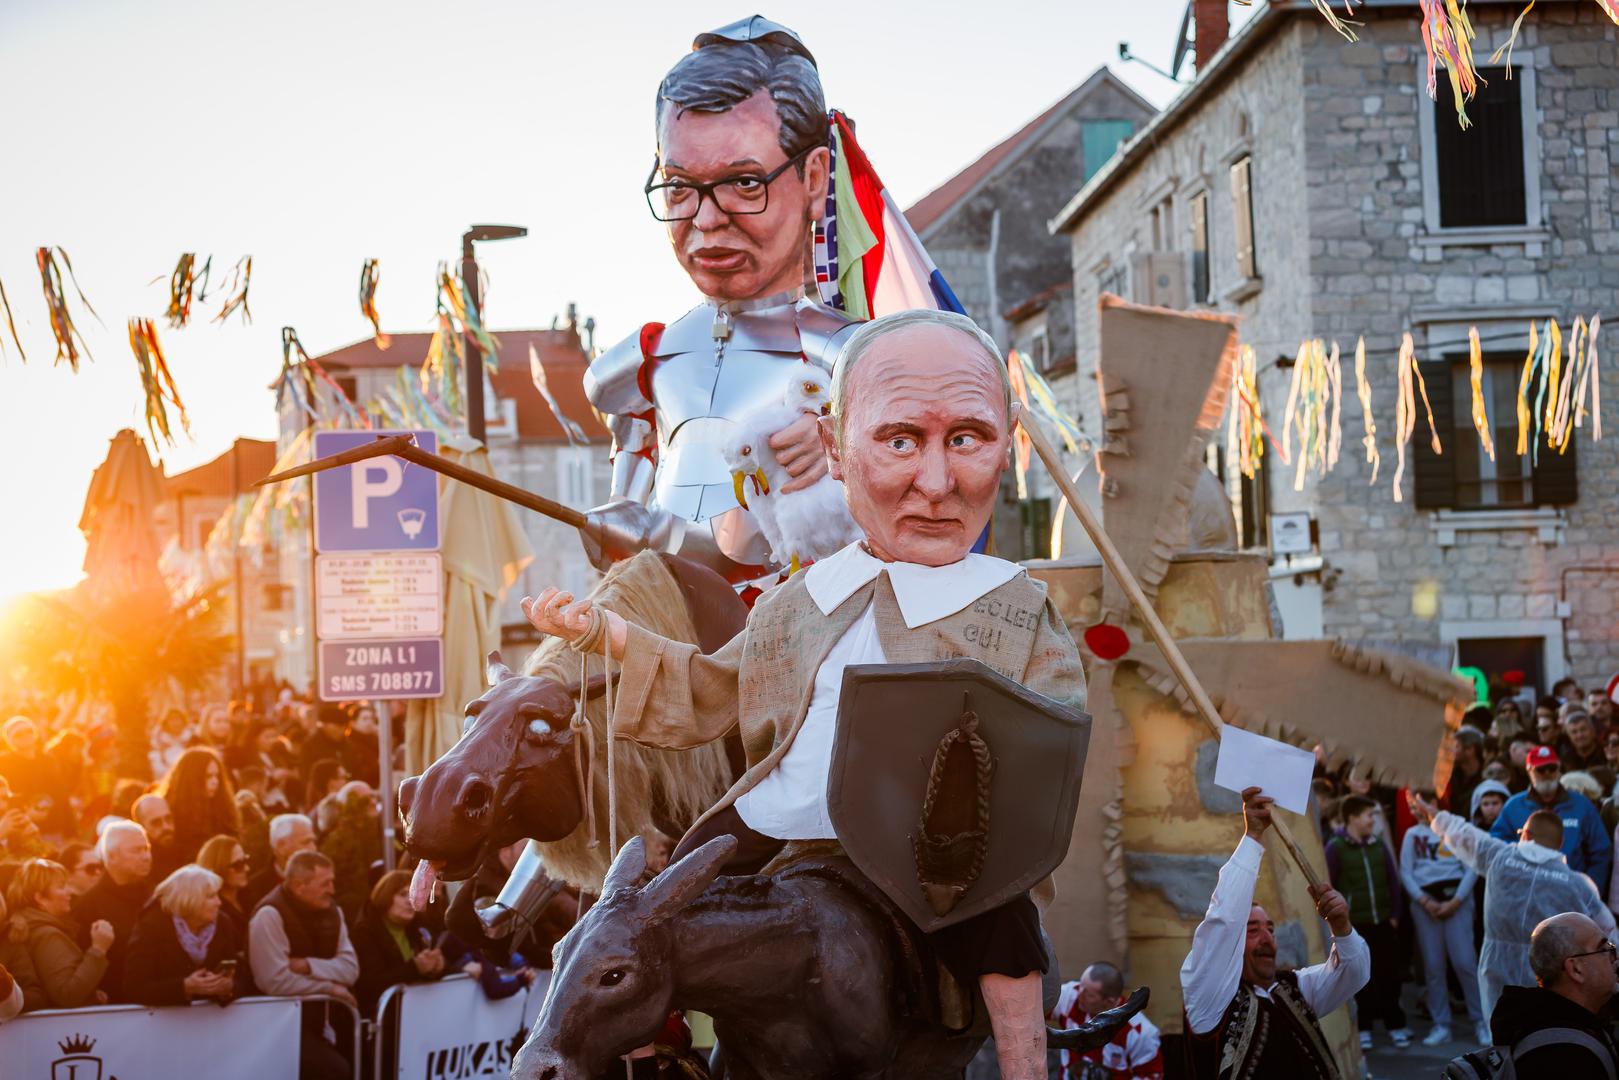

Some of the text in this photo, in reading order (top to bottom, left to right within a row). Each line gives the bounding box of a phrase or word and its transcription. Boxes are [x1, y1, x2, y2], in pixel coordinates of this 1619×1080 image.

[351, 453, 403, 529] P
[345, 646, 416, 666] ZONA L1
[330, 670, 434, 692] SMS 708877
